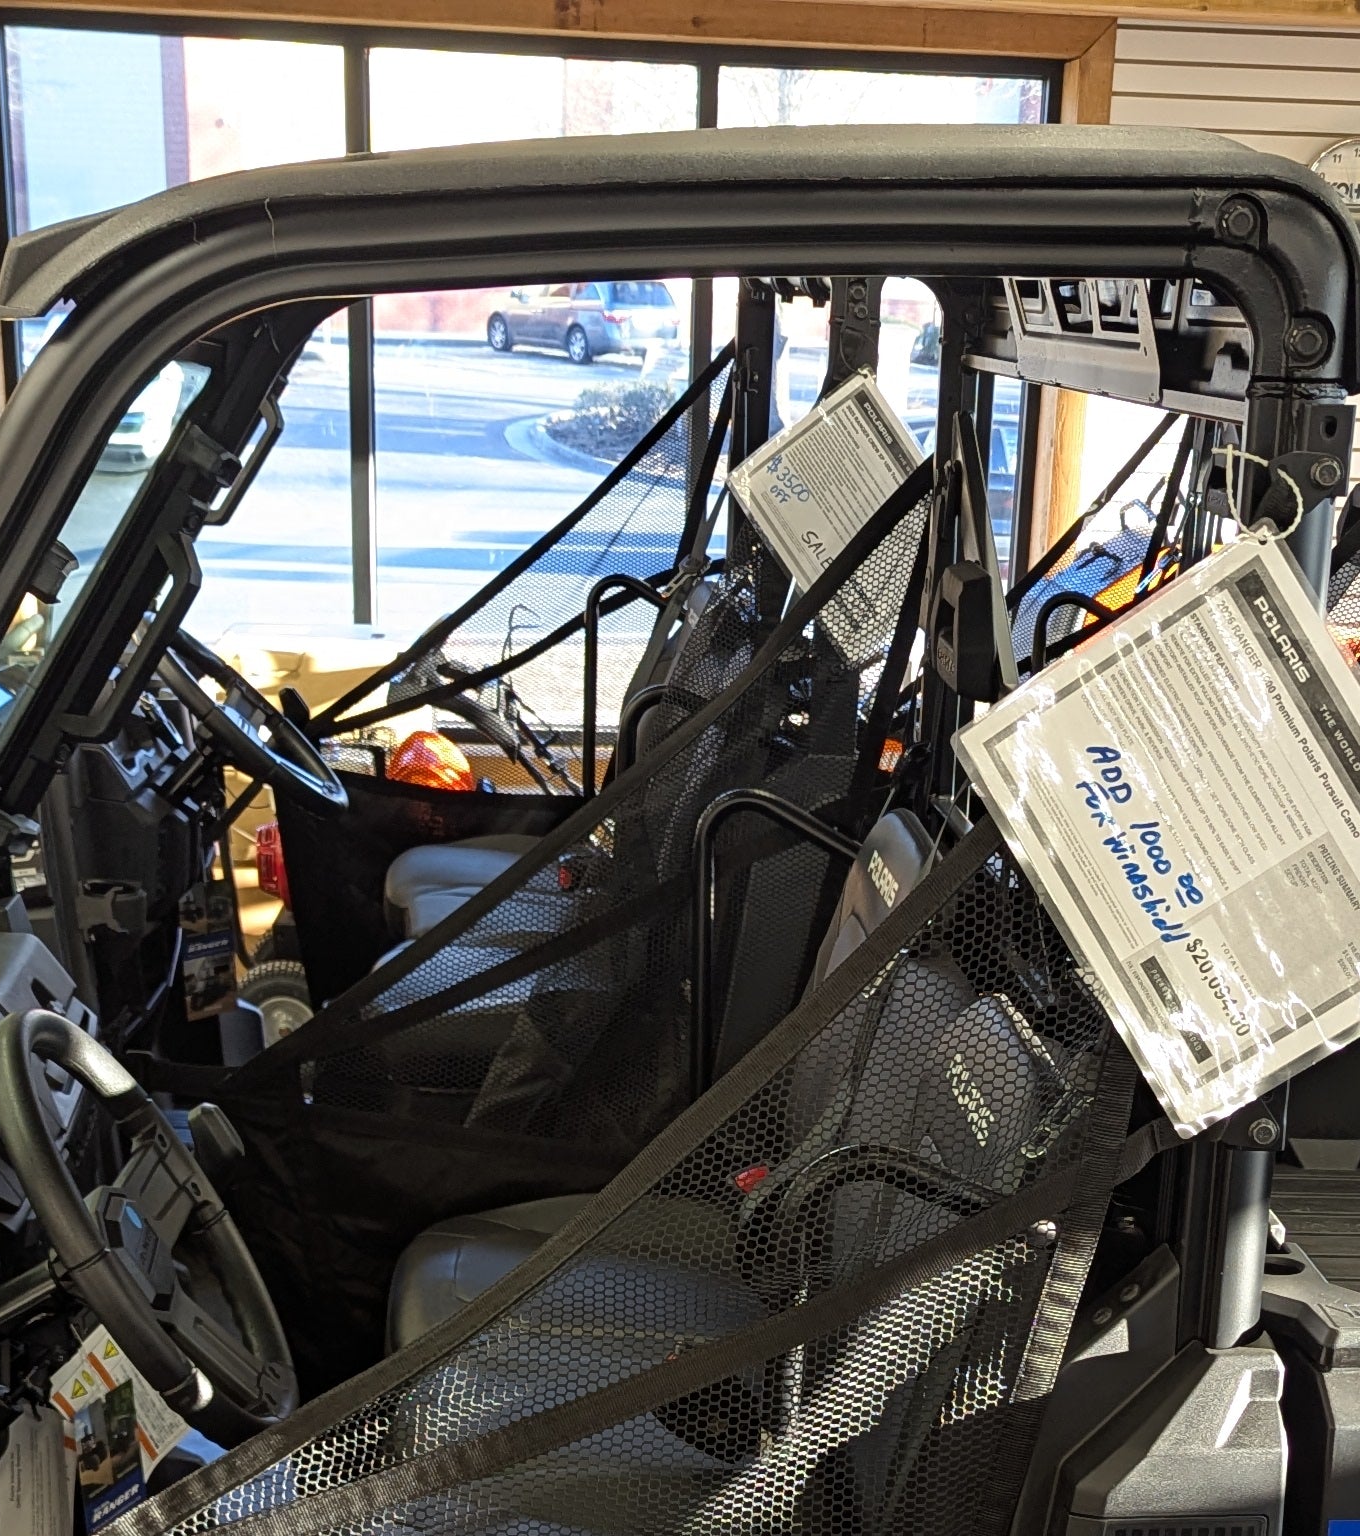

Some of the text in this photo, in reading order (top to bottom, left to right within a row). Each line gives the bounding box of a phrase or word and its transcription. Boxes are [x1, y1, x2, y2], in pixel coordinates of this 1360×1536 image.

[1332, 154, 1342, 163] 11
[852, 416, 870, 438] RANGER
[866, 436, 880, 454] CREW
[877, 452, 885, 462] XP
[861, 401, 895, 445] POLARIS
[765, 454, 811, 504] $3500
[801, 530, 837, 573] SALE
[1189, 612, 1217, 653] STANDARD
[1213, 652, 1240, 691] FEATURES
[1251, 594, 1312, 684] POLARIS
[1317, 703, 1336, 728] THE
[1230, 624, 1262, 670] RANGER
[1271, 693, 1303, 738] Premium
[1297, 736, 1323, 773] Polaris
[1317, 771, 1345, 809] Pursuit
[1085, 744, 1133, 804] ADD
[1129, 819, 1174, 878] 1000
[1298, 858, 1313, 878] TOTAL
[1316, 843, 1340, 876] PRICING
[1219, 942, 1240, 972] TOTAL
[1182, 936, 1254, 1039] $20,094.00
